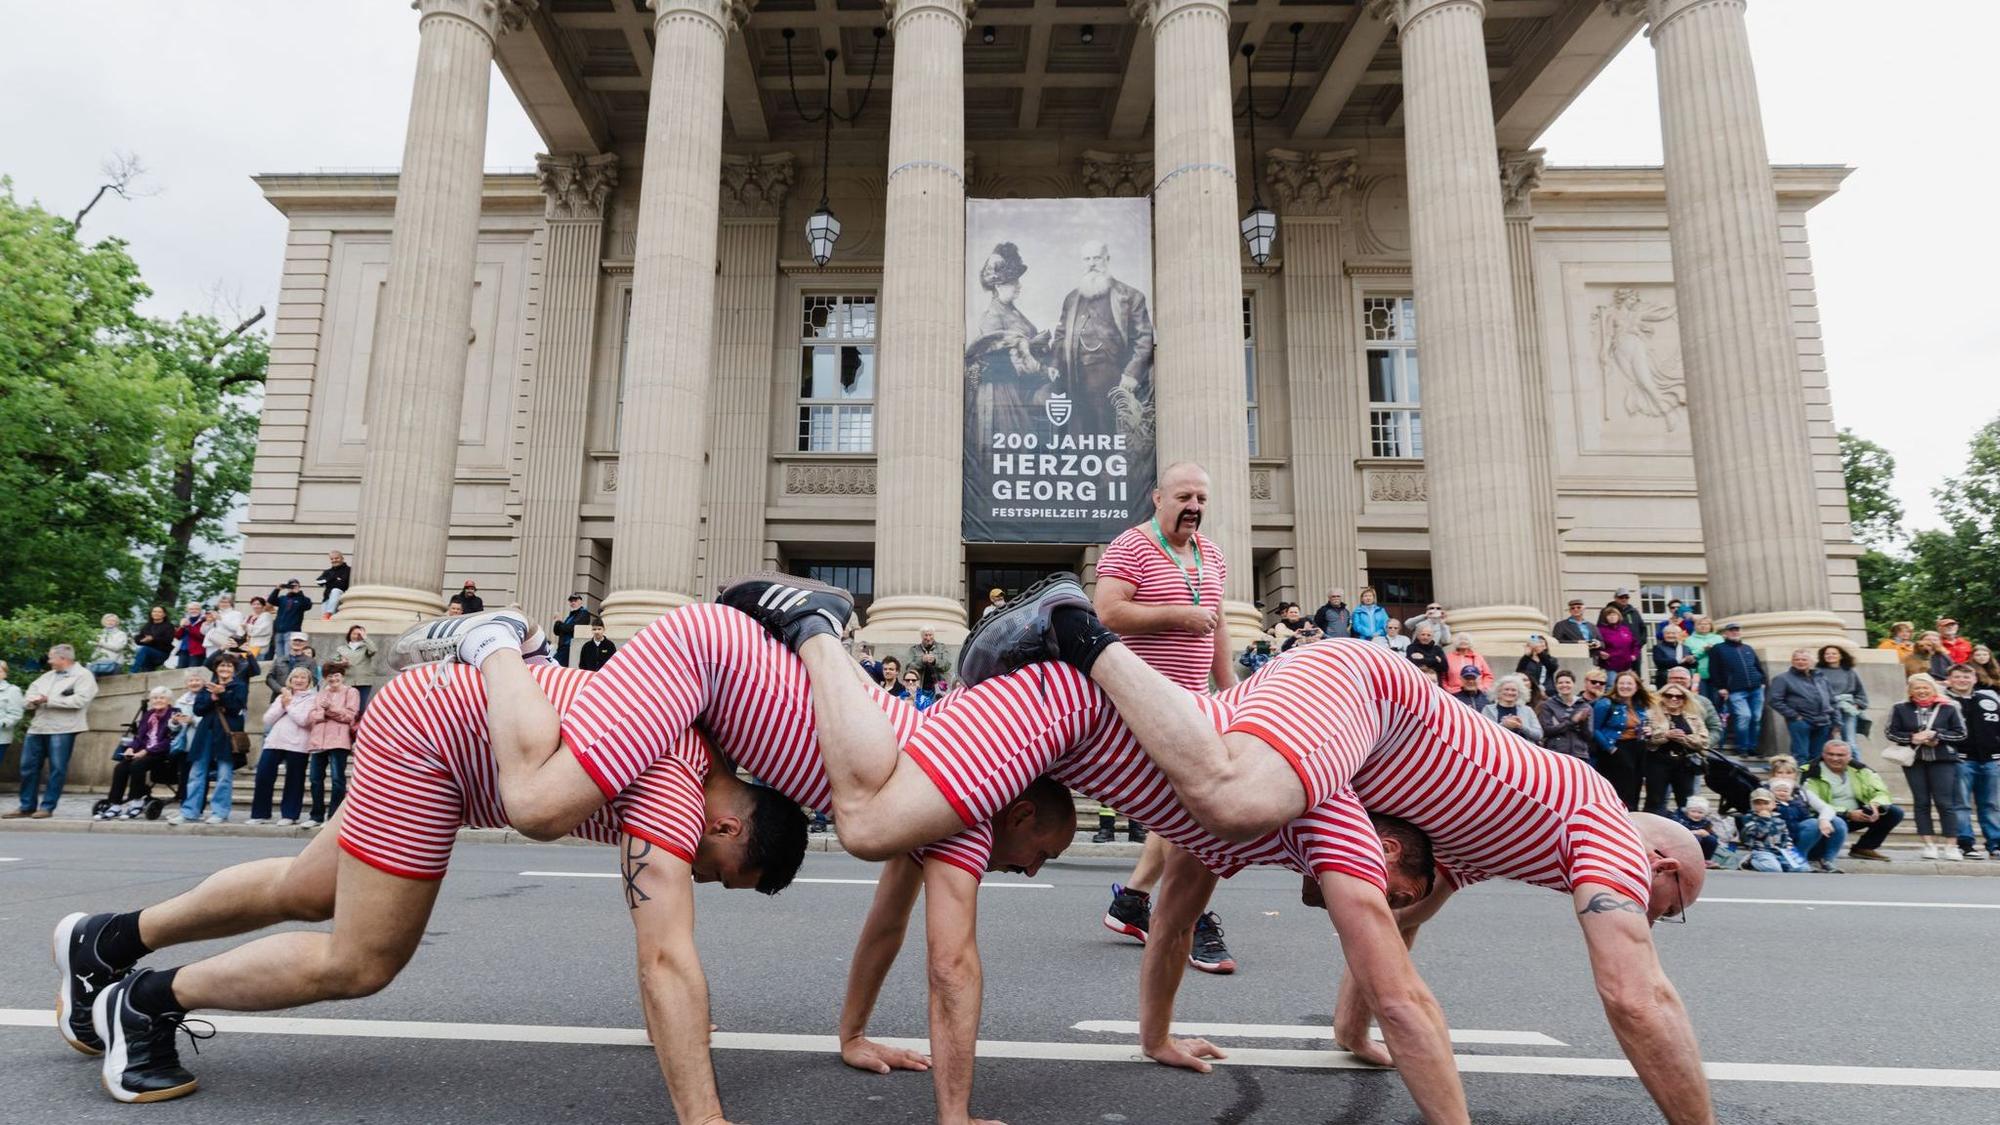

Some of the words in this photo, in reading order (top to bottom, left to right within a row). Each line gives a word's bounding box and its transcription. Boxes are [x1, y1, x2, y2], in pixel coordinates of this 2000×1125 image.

[992, 432, 1038, 449] 200
[1046, 434, 1127, 450] JAHRE
[993, 454, 1128, 476] HERZOG
[992, 480, 1097, 501] GEORG
[1108, 481, 1127, 501] II
[992, 508, 1089, 518] FESTSPIELZEIT
[1092, 509, 1129, 519] 25/26
[1983, 712, 1999, 722] 23
